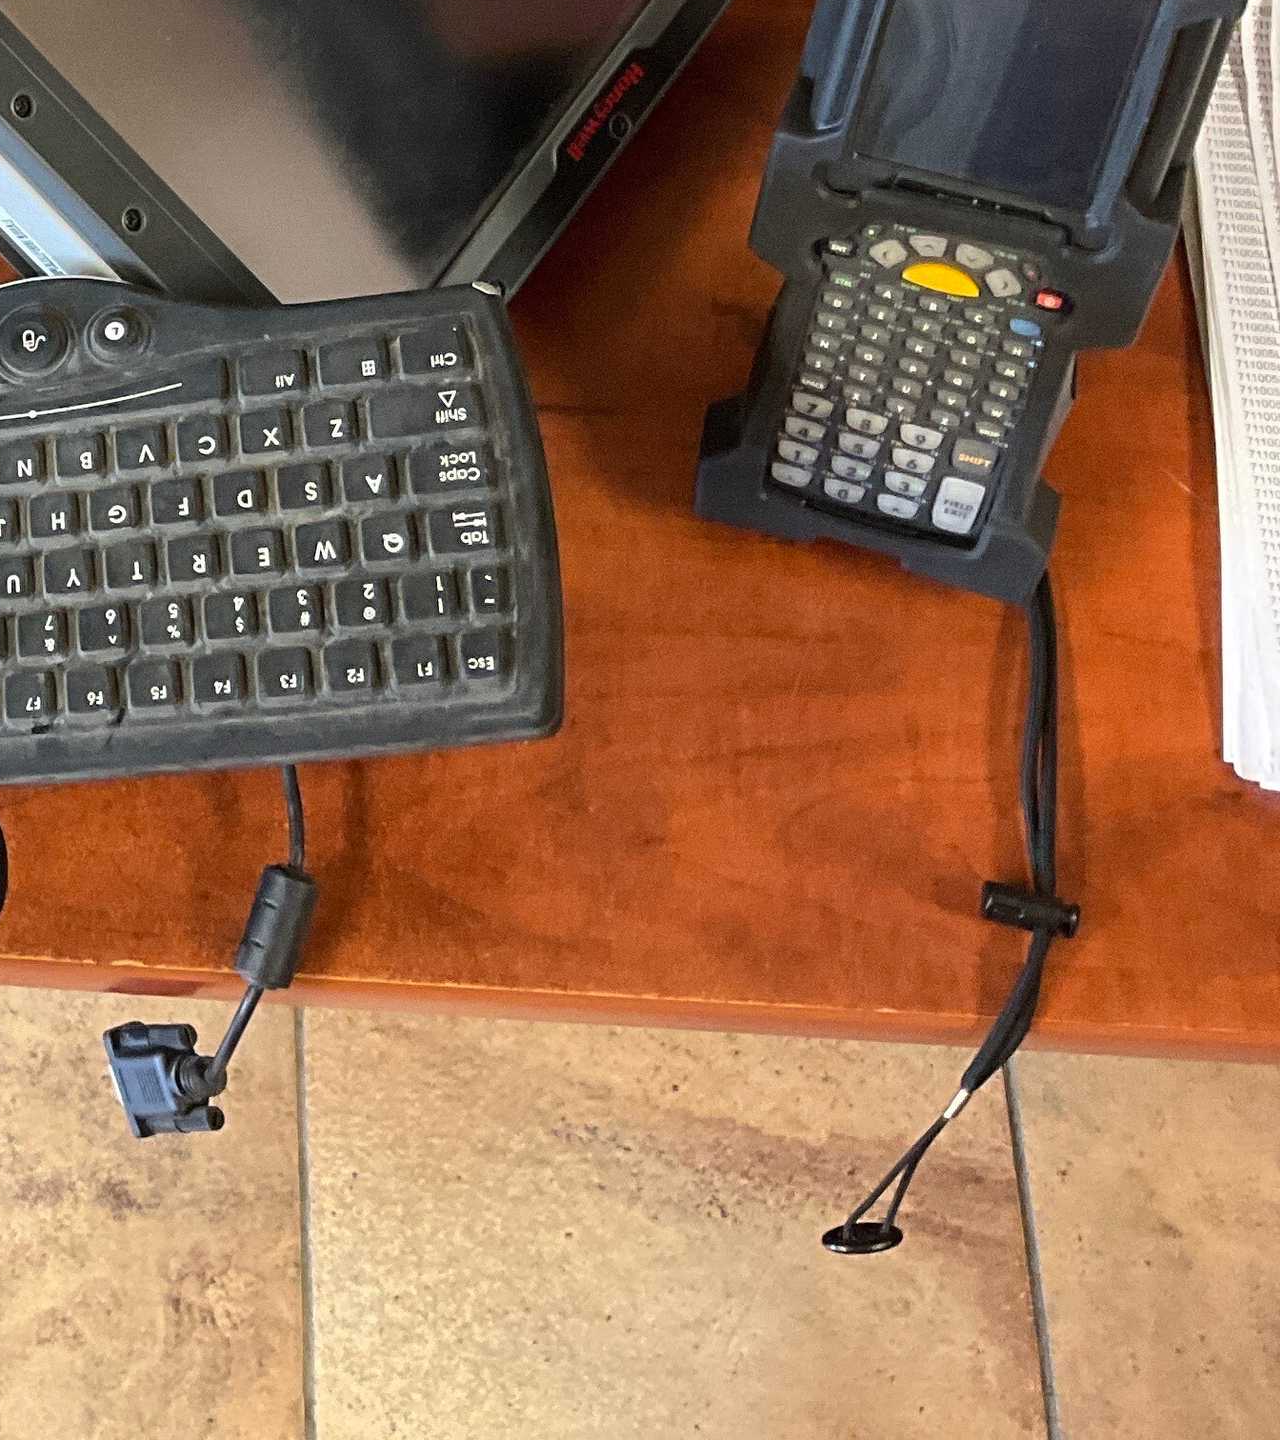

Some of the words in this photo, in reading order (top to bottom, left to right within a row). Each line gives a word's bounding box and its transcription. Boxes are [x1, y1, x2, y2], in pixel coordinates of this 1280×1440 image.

[830, 243, 847, 254] ENT
[431, 353, 457, 367] Ctrl
[275, 374, 294, 388] Alt
[436, 408, 467, 423] Shift
[330, 419, 343, 437] Z
[263, 427, 279, 446] X
[440, 451, 476, 467] Lock
[958, 452, 992, 468] SHIFT
[439, 467, 480, 482] Caps
[305, 482, 317, 500] S
[366, 474, 382, 493] A
[383, 533, 404, 552] Q
[461, 531, 489, 545] Tab
[258, 547, 270, 566] E
[315, 541, 336, 560] W
[418, 662, 432, 676] F1
[468, 656, 494, 670] Esc
[280, 674, 297, 688] F3
[347, 668, 364, 683] F2
[151, 686, 167, 700] F5
[214, 680, 231, 694] F4
[26, 696, 40, 711] F7
[87, 691, 103, 705] F6
